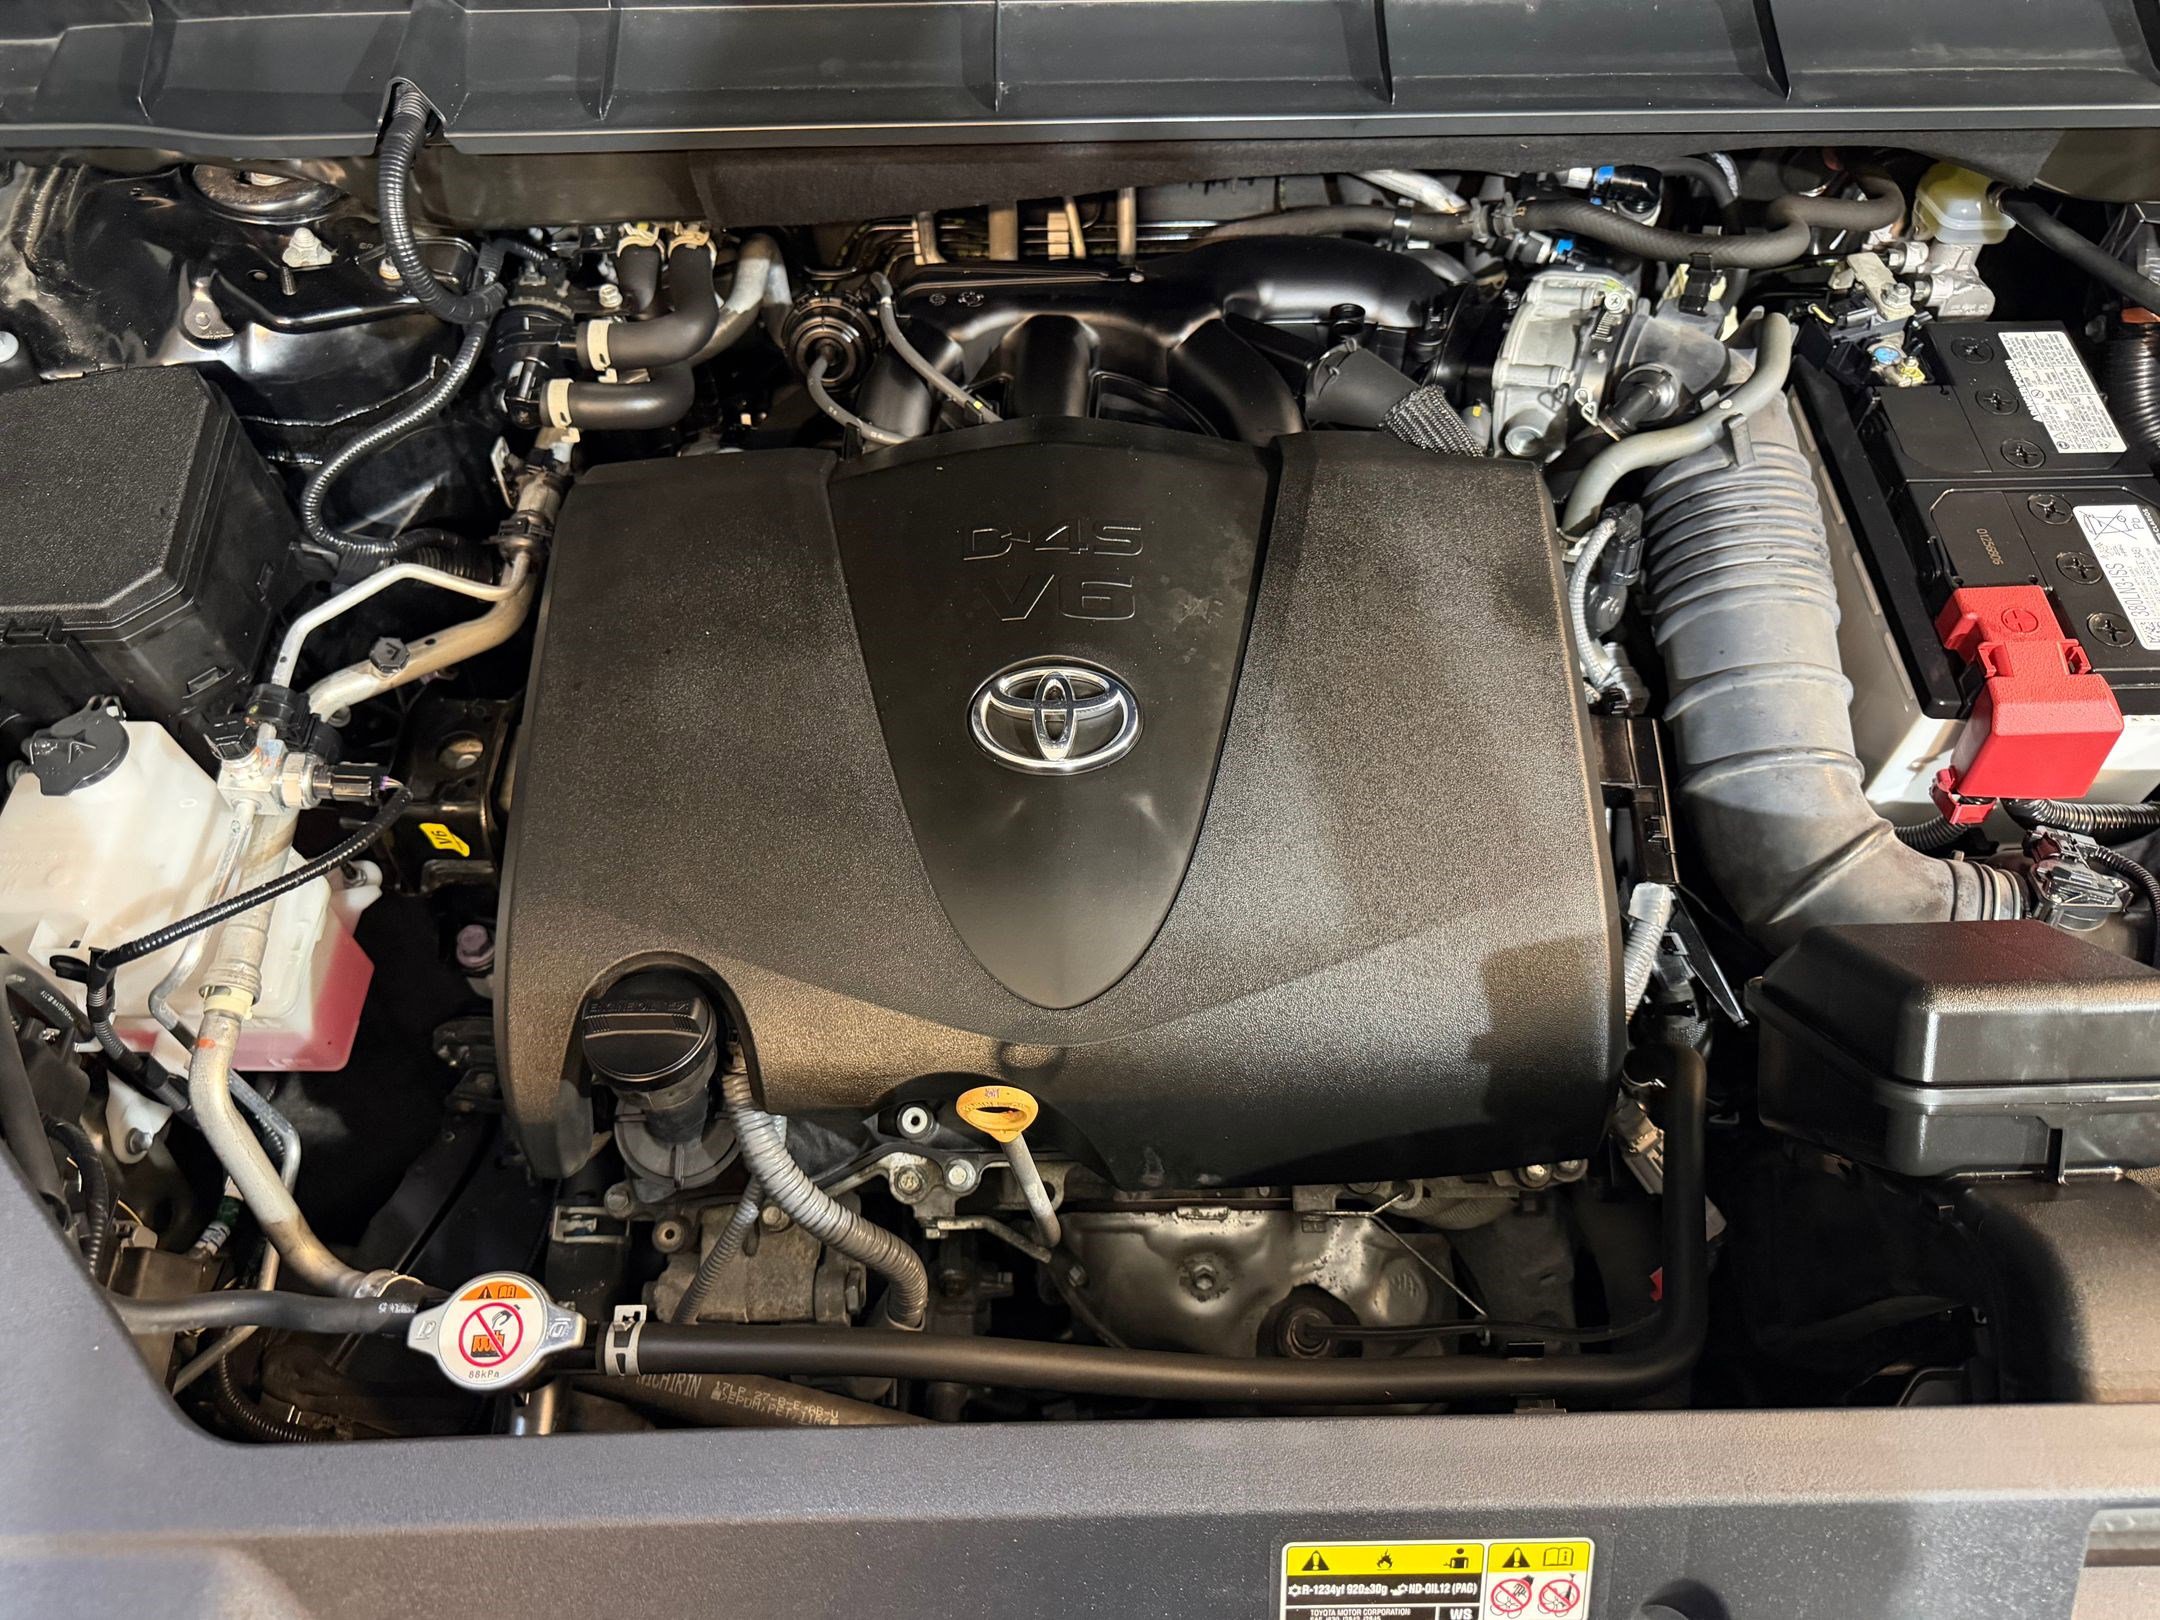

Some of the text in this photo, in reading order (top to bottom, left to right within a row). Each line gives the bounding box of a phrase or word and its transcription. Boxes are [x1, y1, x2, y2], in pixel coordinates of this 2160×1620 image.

[963, 520, 1143, 560] D-4S
[976, 573, 1136, 621] V6
[1302, 1584, 1345, 1597] R-1234yf
[1452, 1582, 1478, 1596] (PAG)
[1310, 1607, 1411, 1617] TOYOTA MOTOR CORPORATION
[1450, 1608, 1473, 1620] WS
